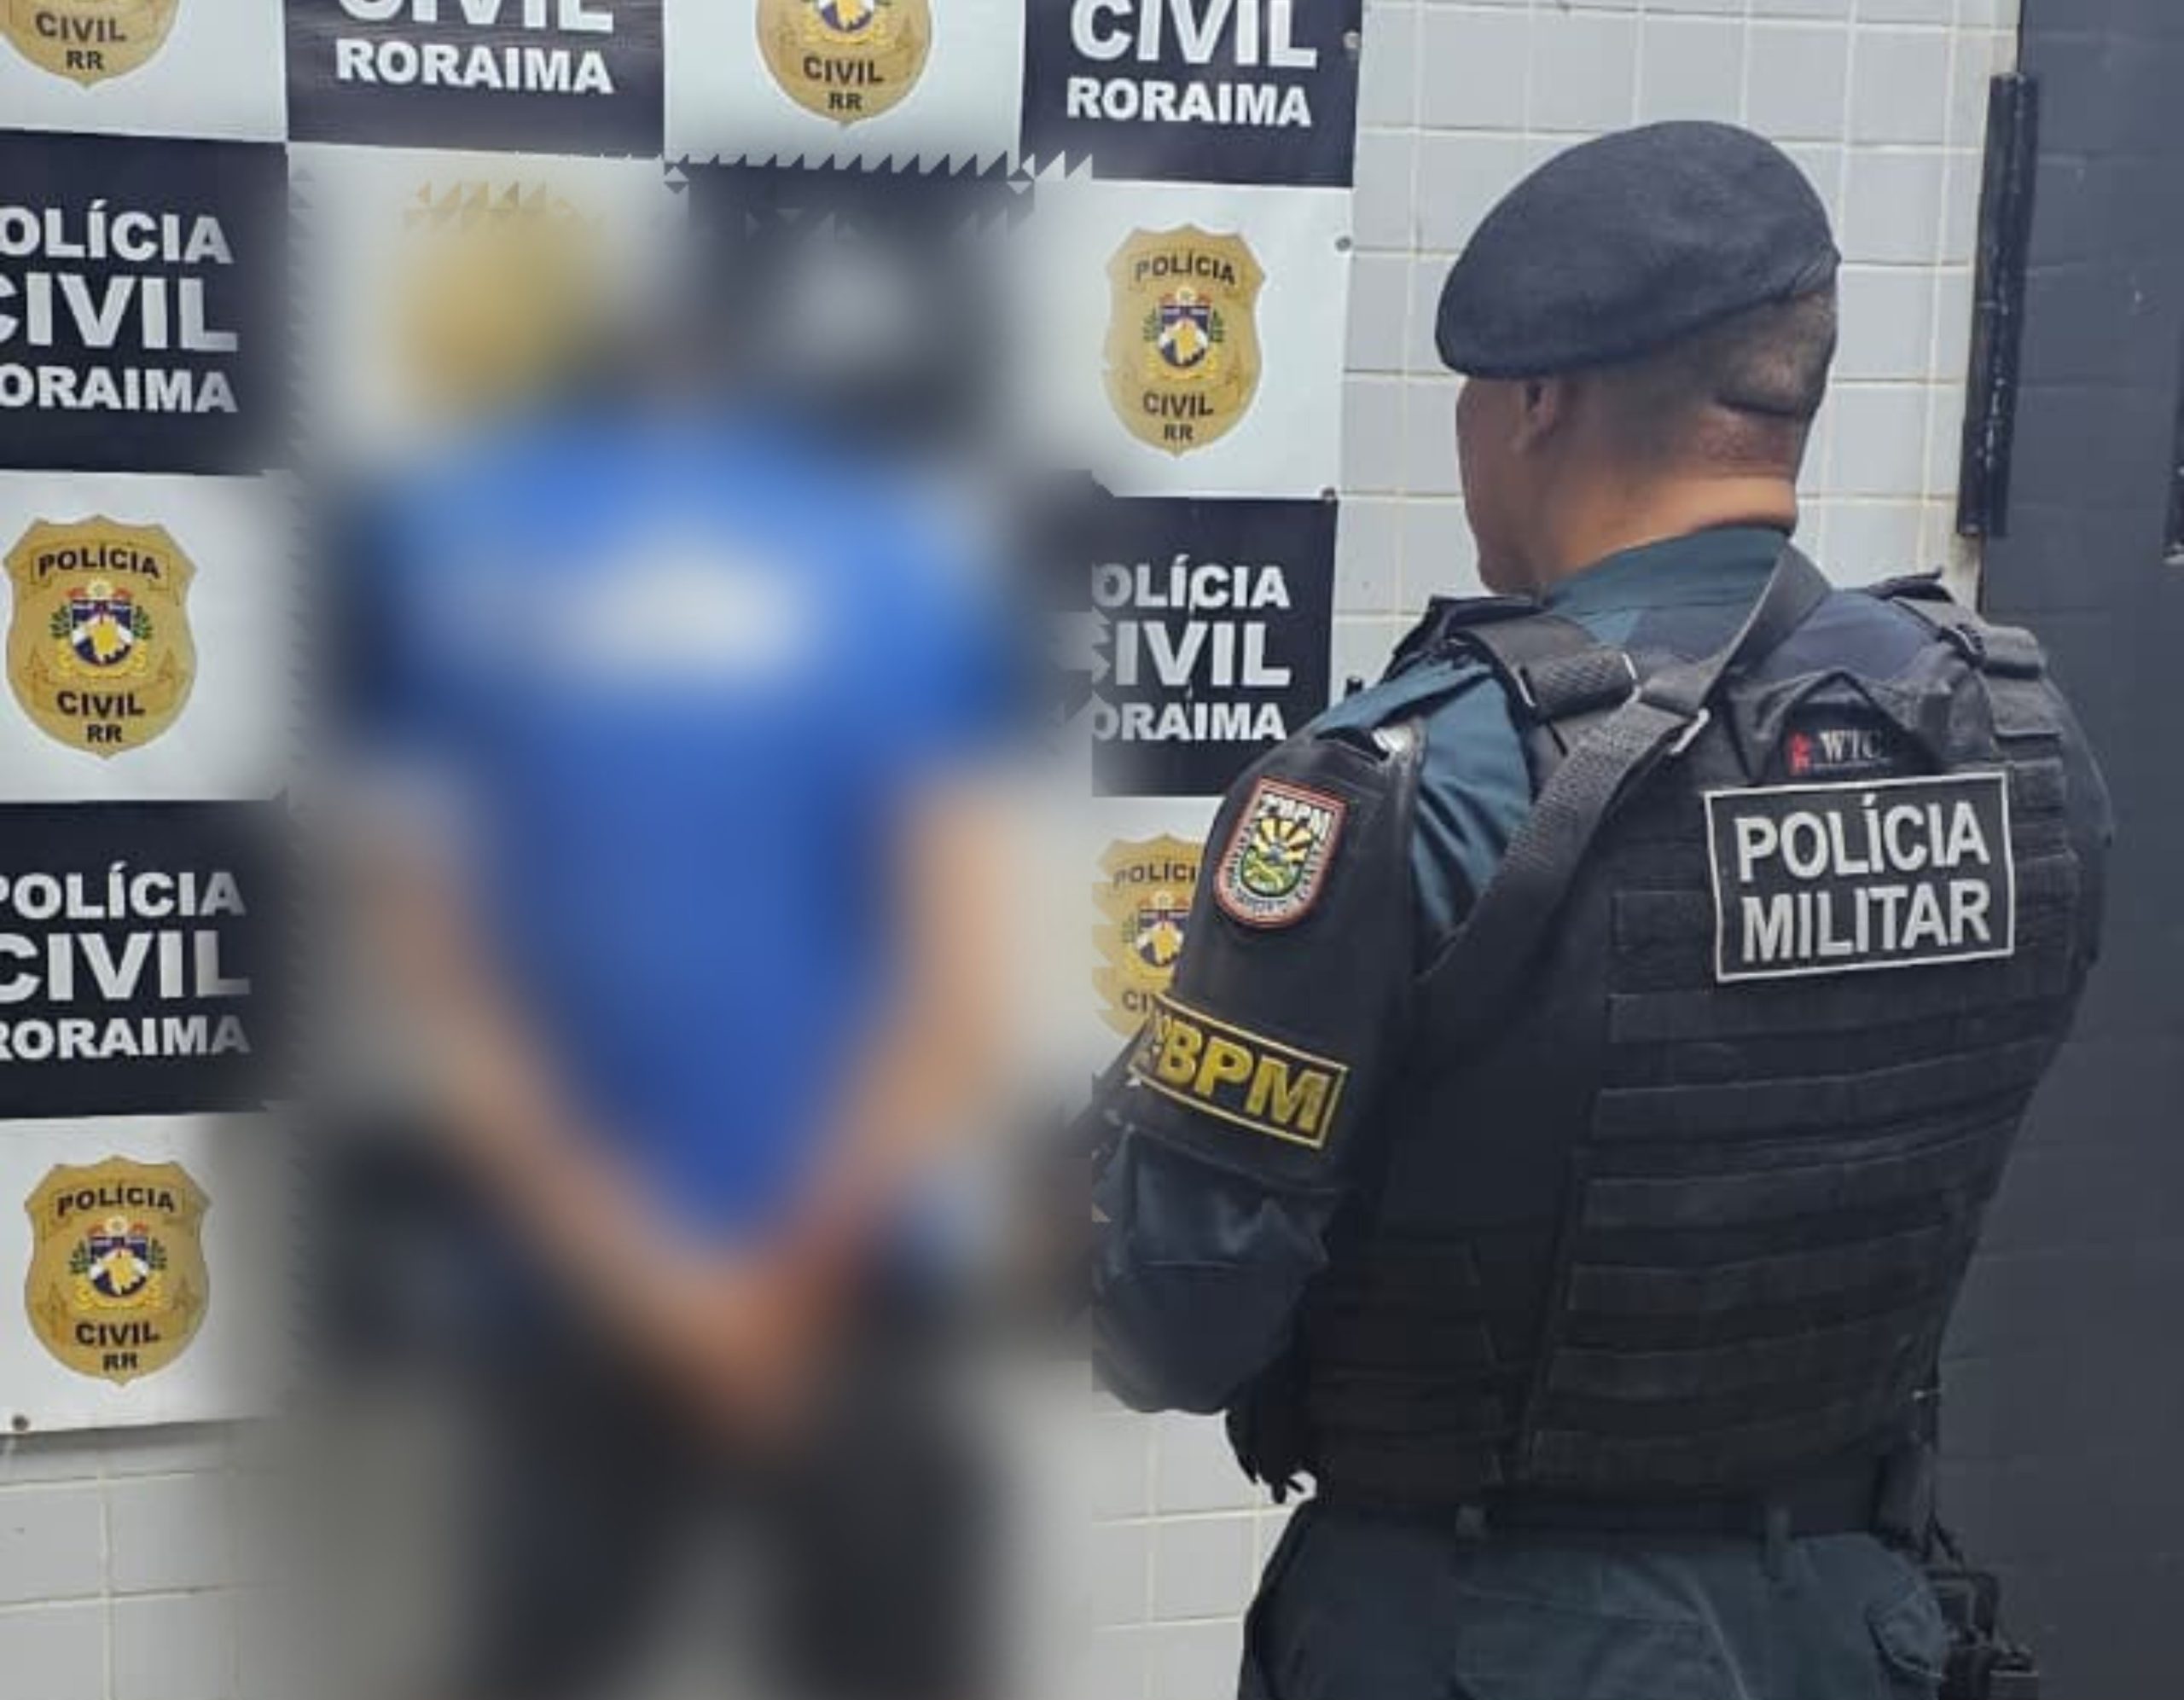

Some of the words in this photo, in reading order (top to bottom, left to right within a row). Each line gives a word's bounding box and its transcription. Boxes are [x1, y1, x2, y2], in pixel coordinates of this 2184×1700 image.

[36, 11, 127, 42] CIVIL
[1071, 0, 1317, 68] CIVIL
[67, 49, 105, 70] RR
[336, 38, 613, 94] RORAIMA
[804, 55, 884, 84] CIVIL
[829, 91, 862, 110] RR
[1067, 77, 1311, 127] RORAIMA
[0, 199, 234, 264] OLÍCIA
[1135, 249, 1235, 286] POLÍCIA
[0, 363, 238, 413] ORAIMA
[1143, 392, 1214, 418] CIVIL
[1164, 423, 1194, 440] RR
[39, 545, 160, 578] POLÍCIA
[1091, 554, 1291, 609] OLÍCIA
[1092, 620, 1291, 686] IVIL
[57, 691, 145, 717] CIVIL
[1091, 699, 1287, 740] ORAIMA
[87, 724, 123, 743] RR
[1734, 793, 1989, 882] POLÍCIA
[0, 861, 247, 920] OLÍCIA
[1741, 879, 1990, 961] MILITAR
[56, 1184, 175, 1217] POLÍCIA
[75, 1322, 160, 1347] CIVIL
